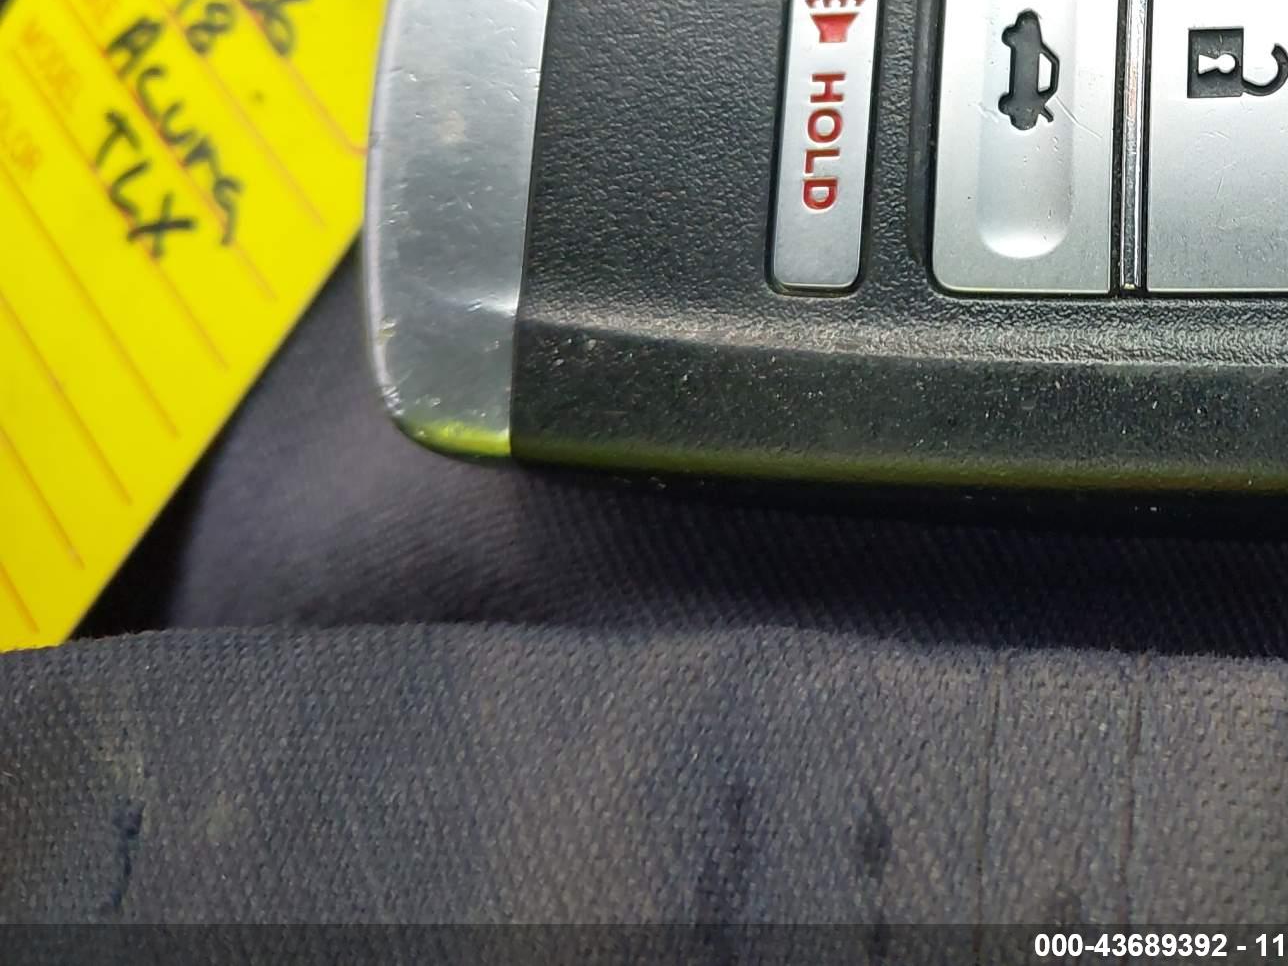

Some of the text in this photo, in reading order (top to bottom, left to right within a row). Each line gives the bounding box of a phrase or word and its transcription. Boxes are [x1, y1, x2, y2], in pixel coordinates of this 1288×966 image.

[95, 110, 196, 260] TLX
[106, 16, 243, 248] Acura
[802, 72, 846, 210] HOLD
